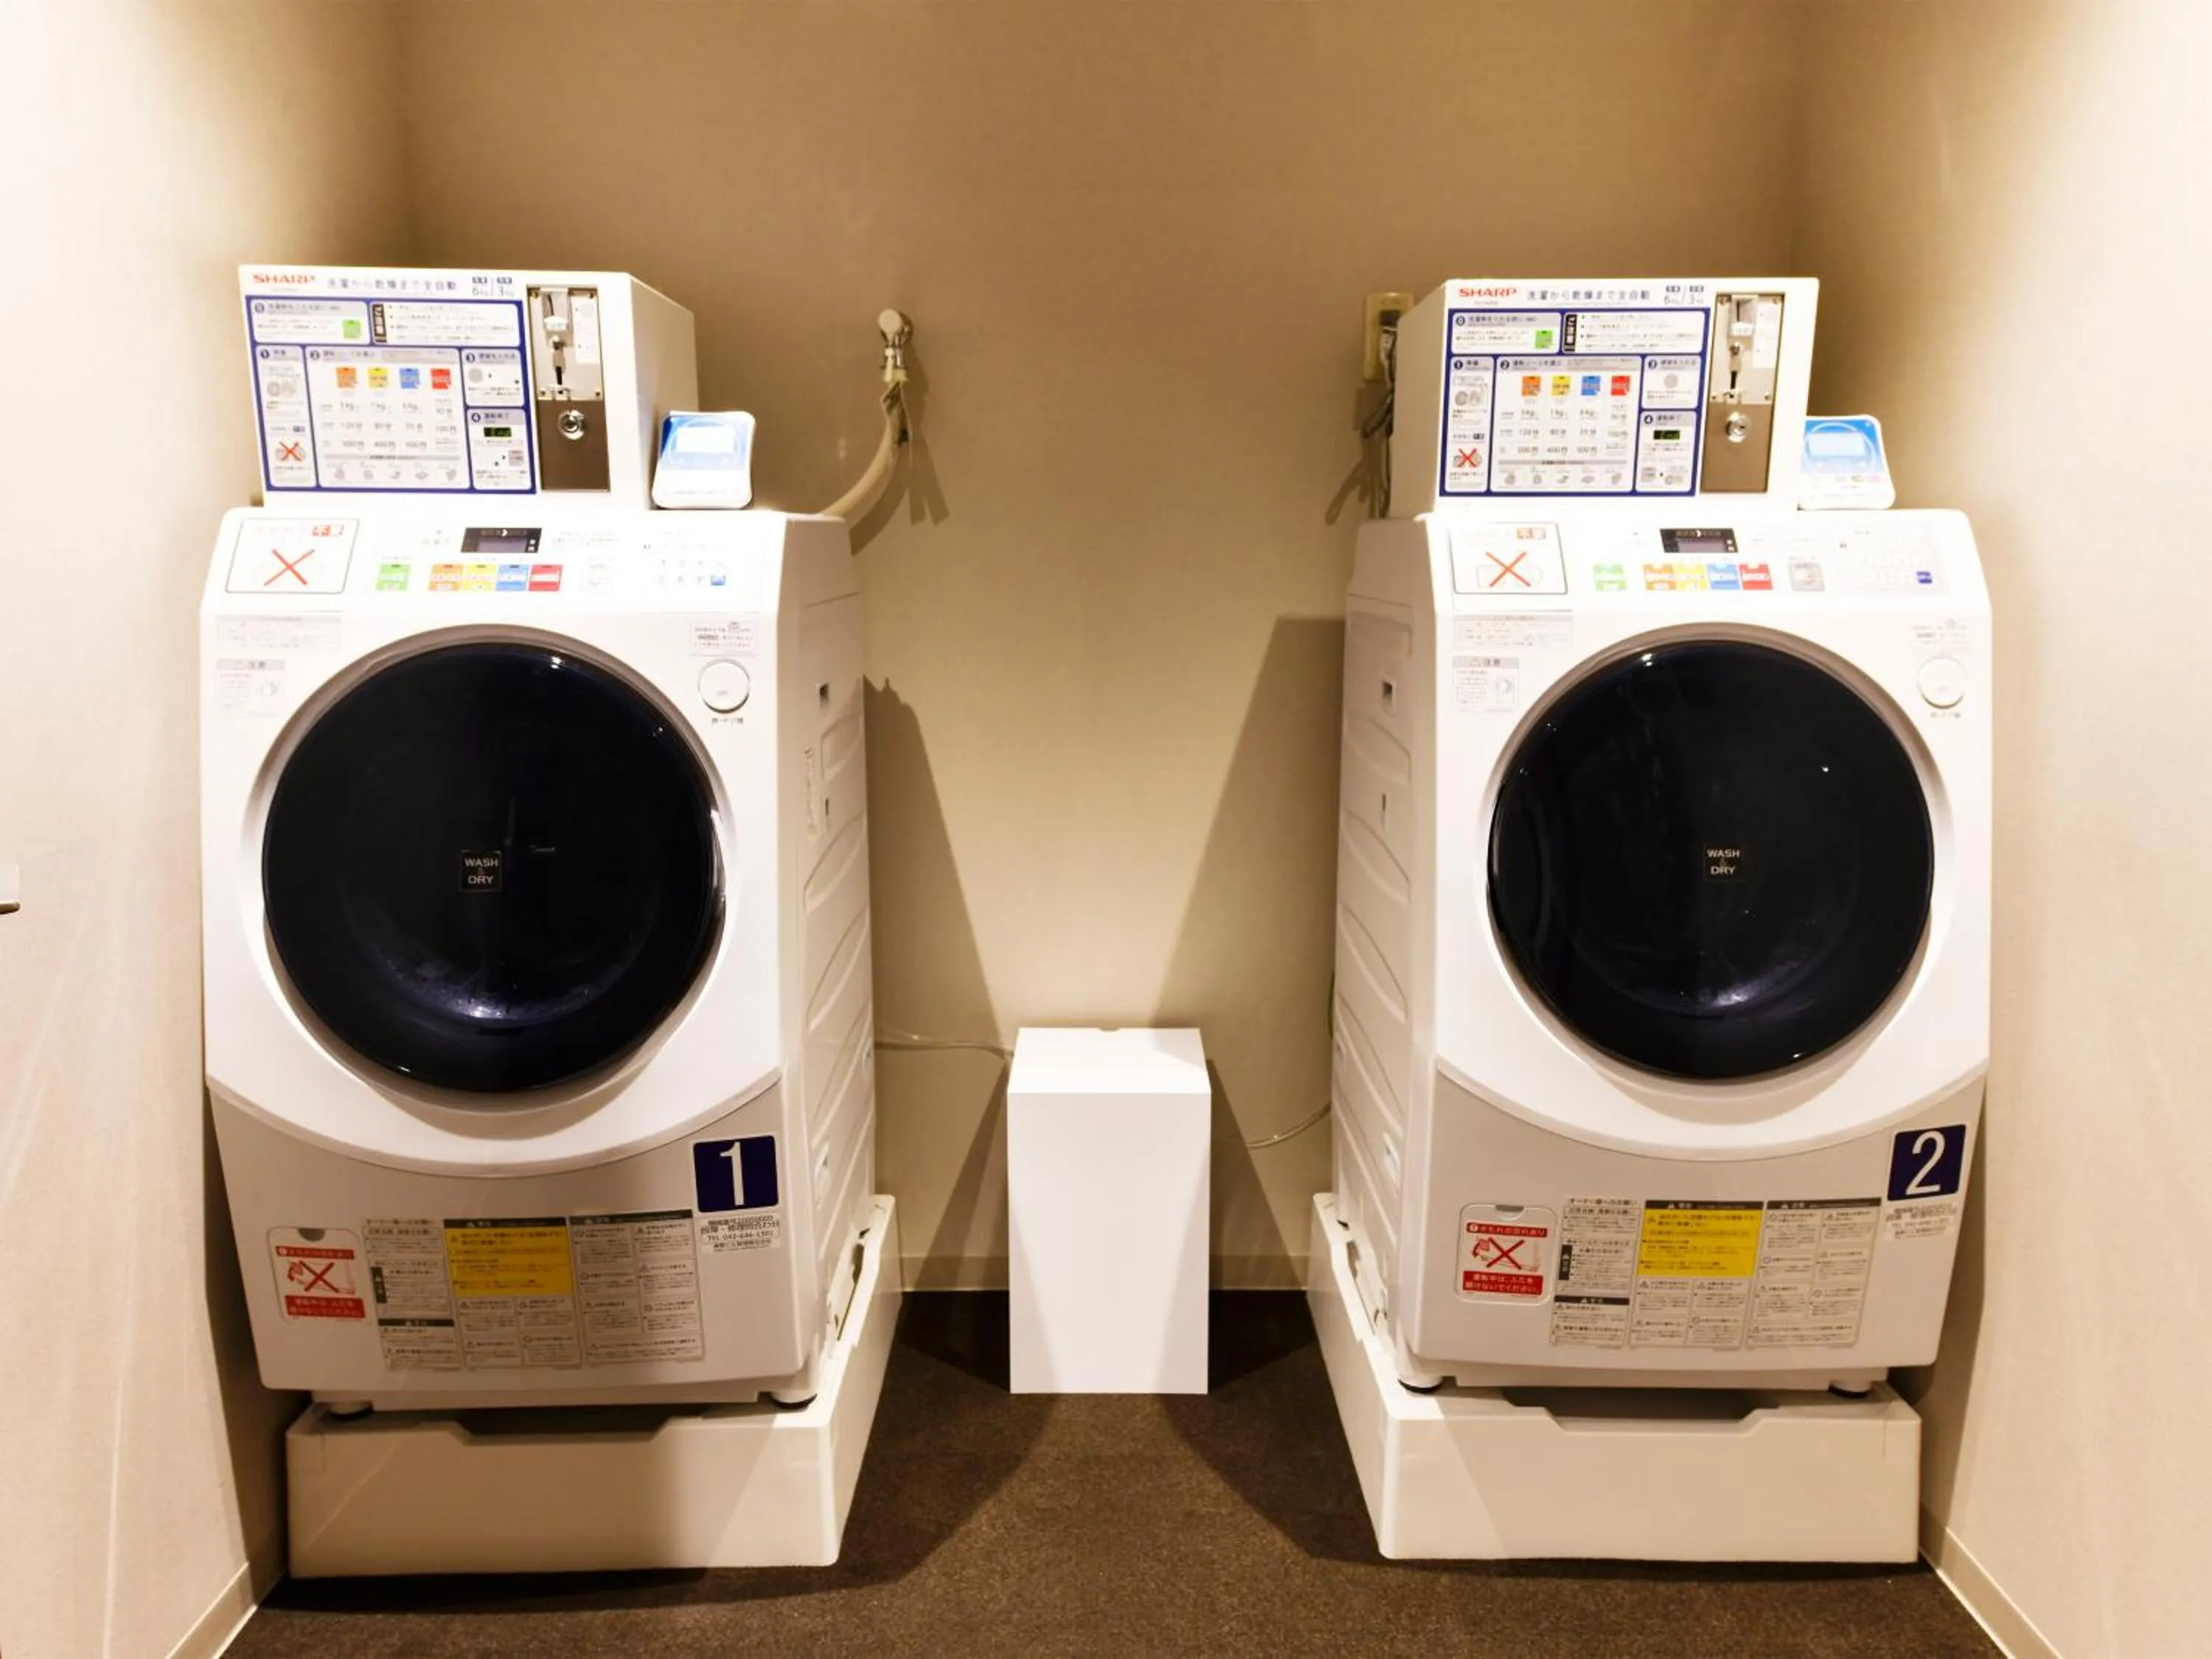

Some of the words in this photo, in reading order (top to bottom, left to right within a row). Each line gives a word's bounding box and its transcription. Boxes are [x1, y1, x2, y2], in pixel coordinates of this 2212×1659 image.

[253, 274, 316, 284] SHARP
[1458, 288, 1517, 297] SHARP
[1707, 849, 1741, 858] WASH
[465, 858, 498, 867] WASH
[1711, 866, 1737, 874] DRY
[468, 875, 493, 884] DRY
[1905, 1130, 1945, 1195] 2
[720, 1141, 744, 1206] 1
